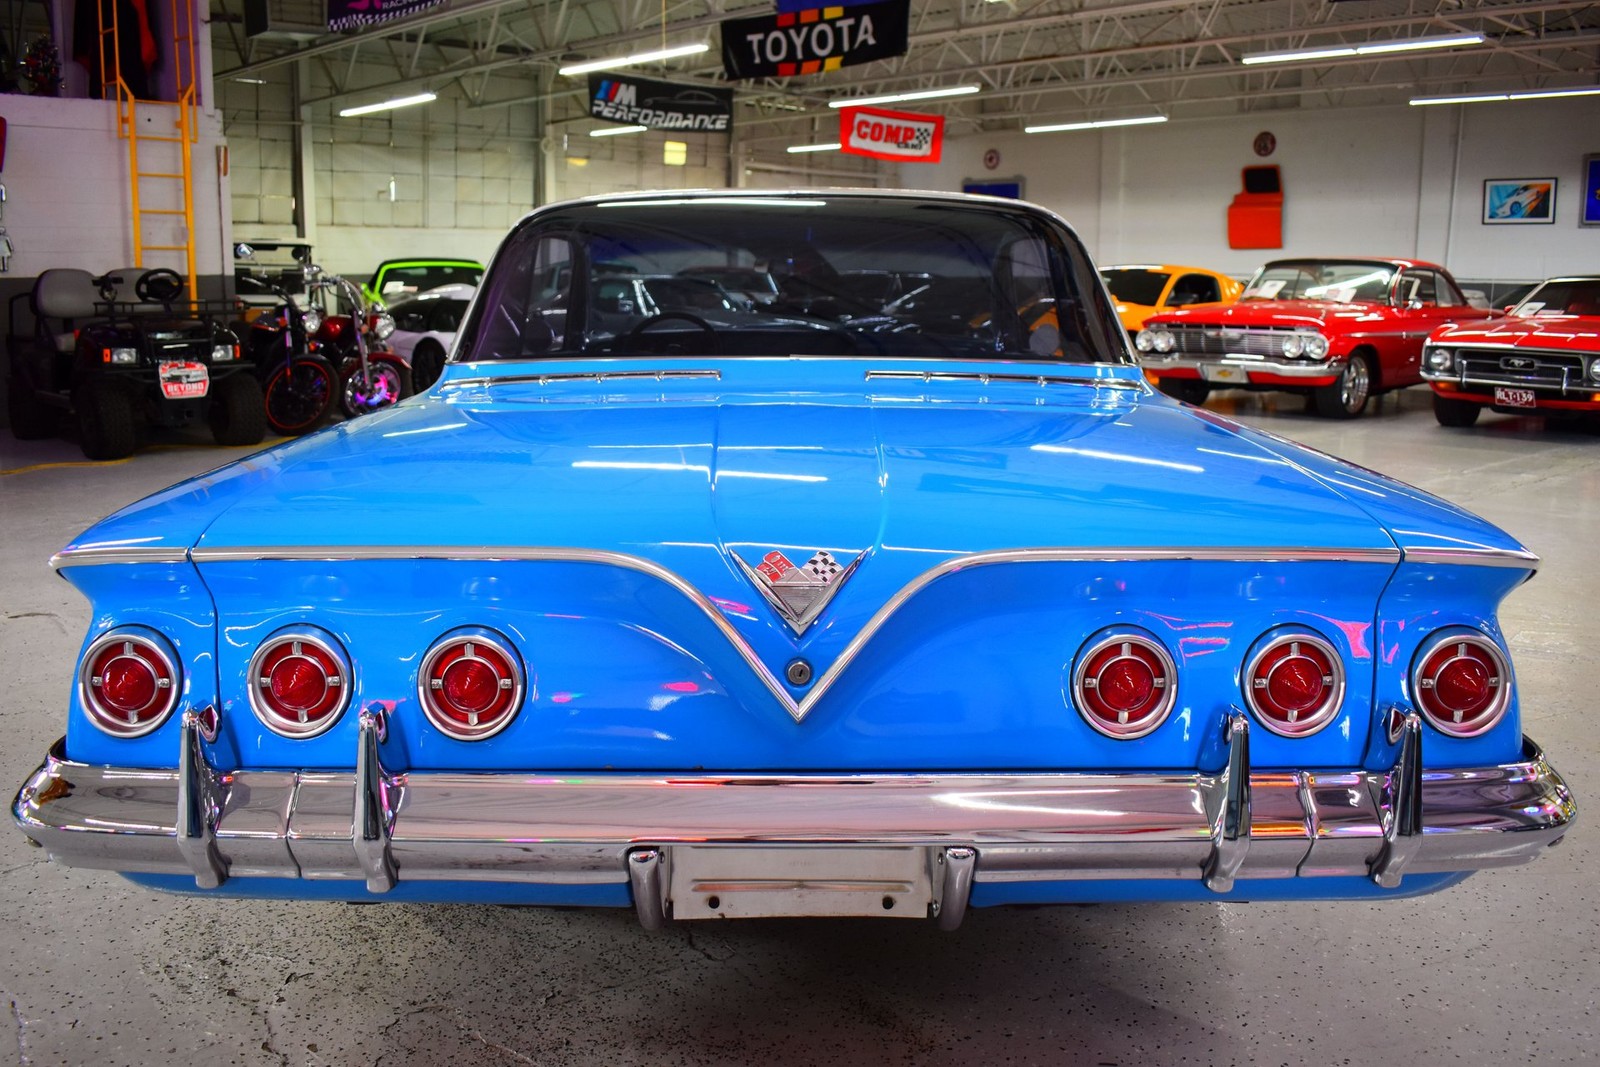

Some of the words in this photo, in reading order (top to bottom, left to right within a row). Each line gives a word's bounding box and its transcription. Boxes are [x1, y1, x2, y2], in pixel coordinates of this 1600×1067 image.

[746, 14, 877, 64] TOYOTA
[592, 100, 730, 130] PERFORMANCE
[857, 120, 915, 144] COMP
